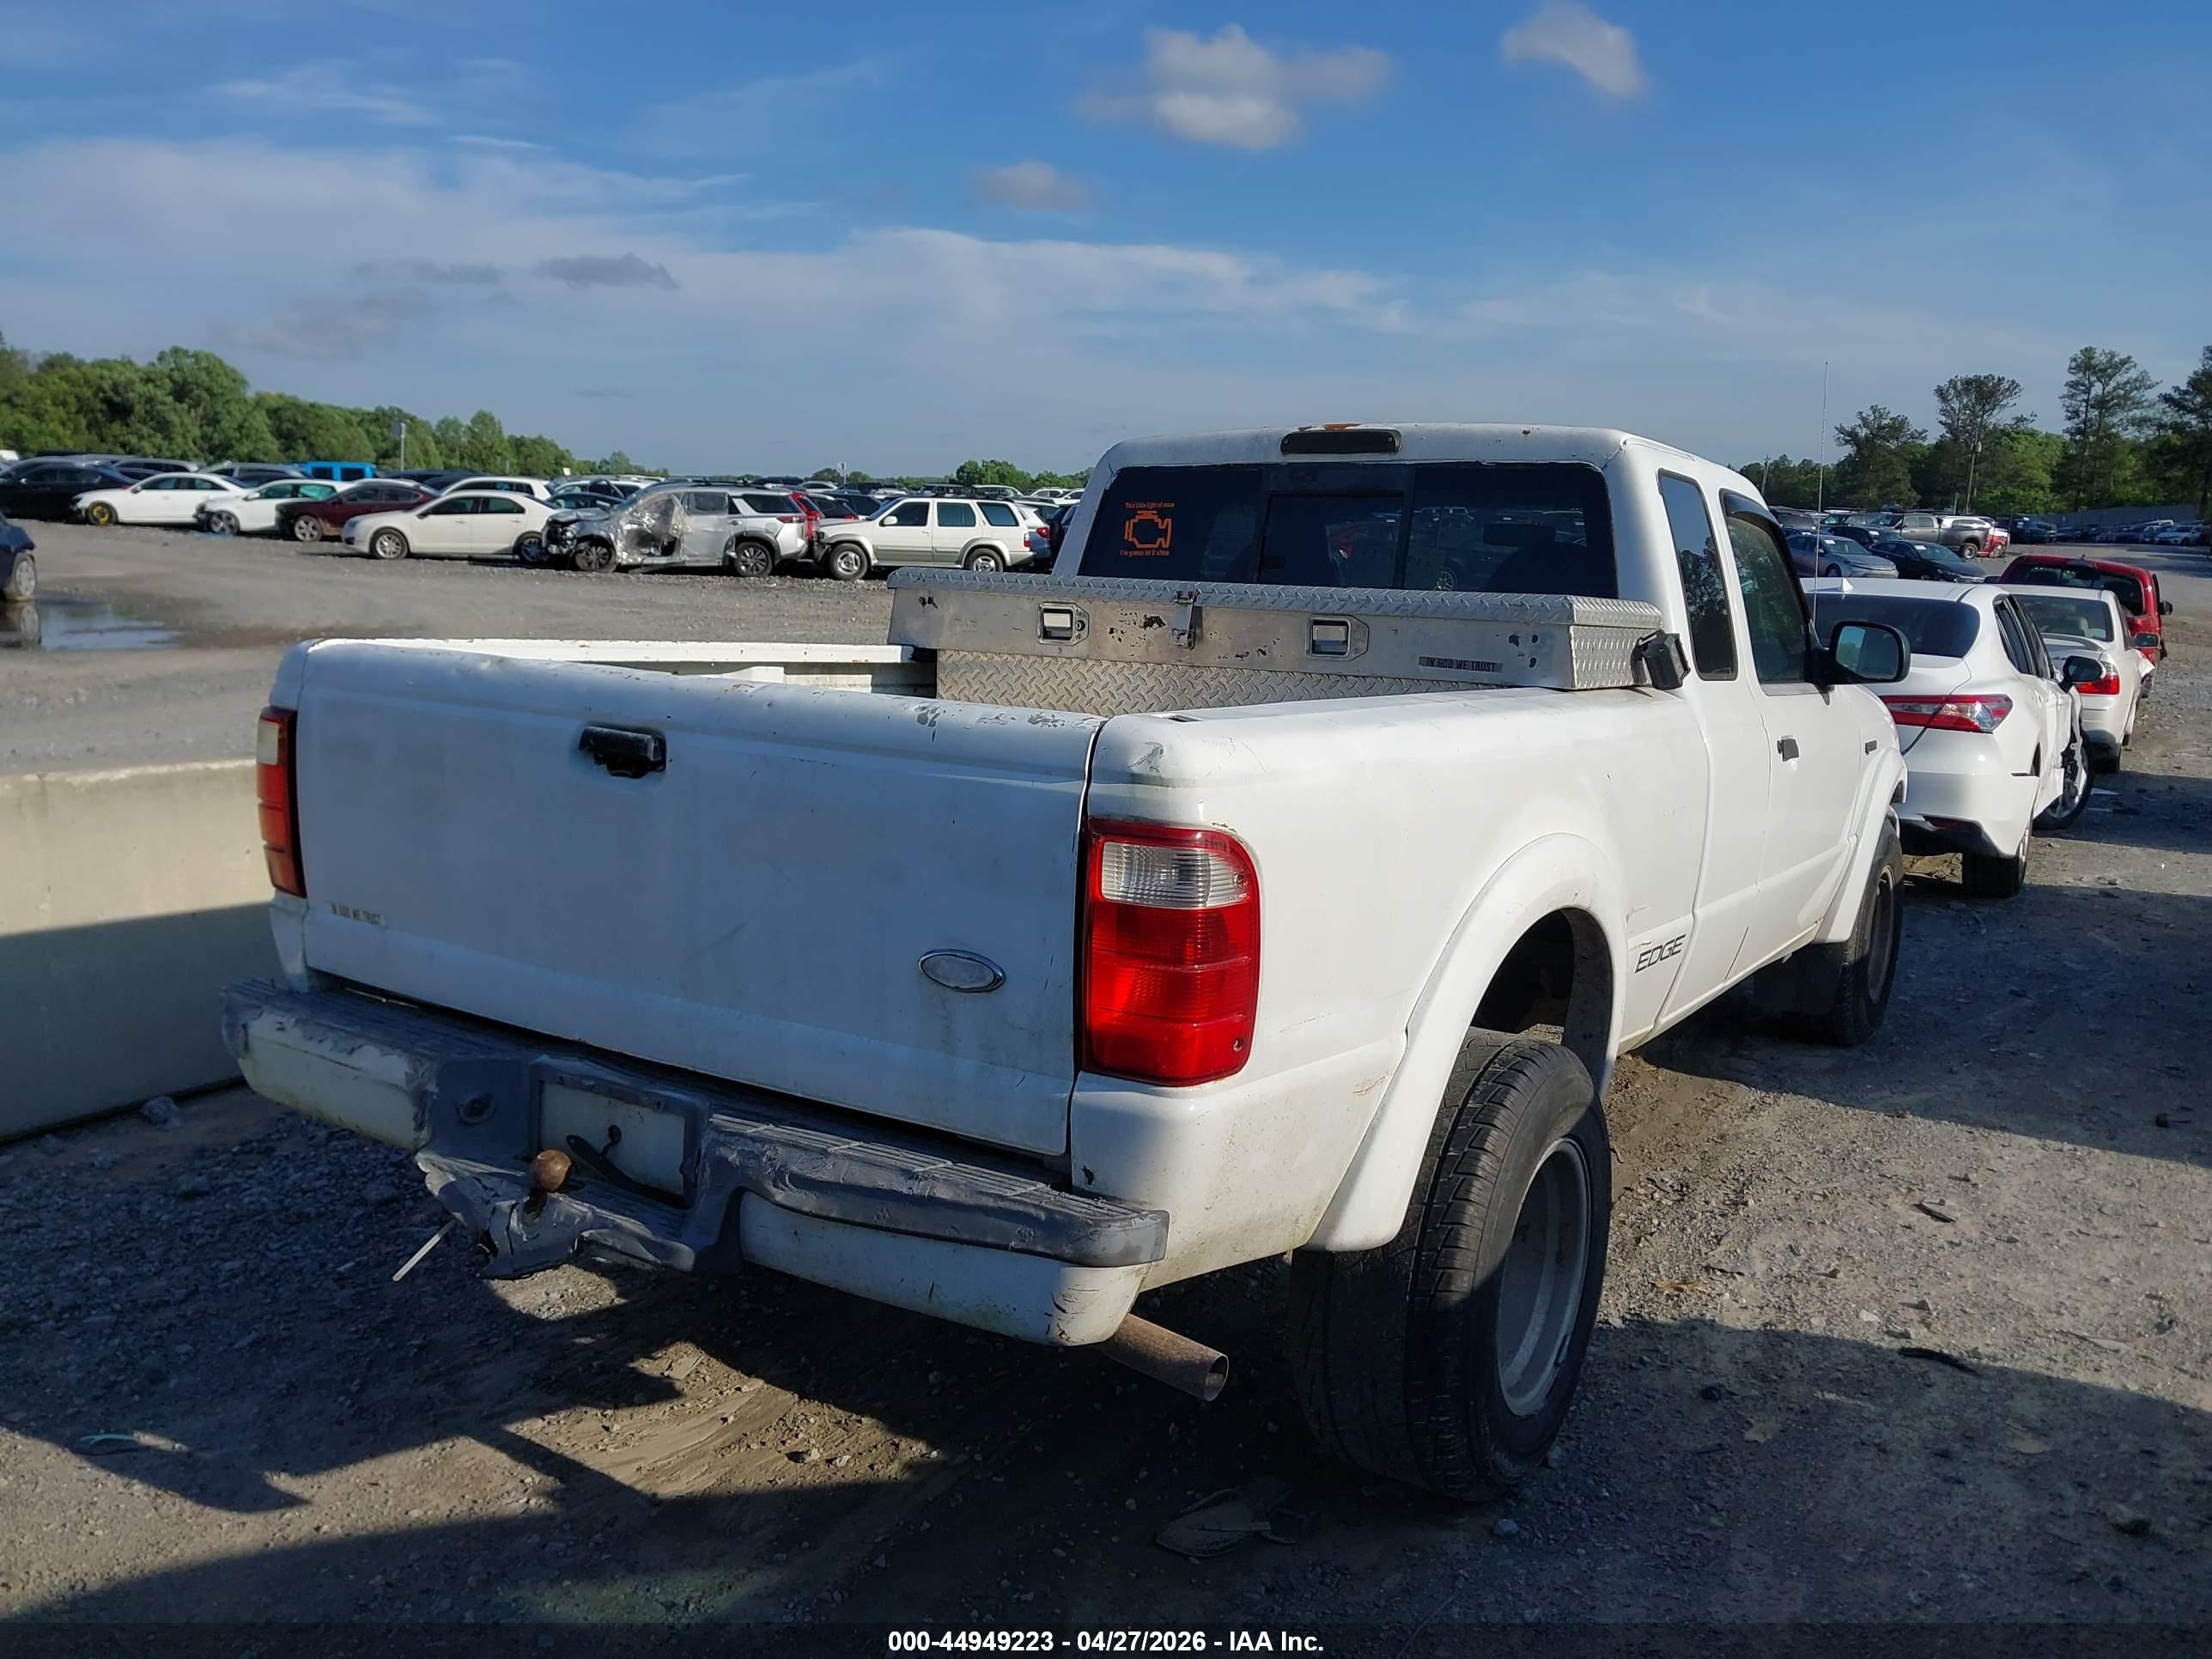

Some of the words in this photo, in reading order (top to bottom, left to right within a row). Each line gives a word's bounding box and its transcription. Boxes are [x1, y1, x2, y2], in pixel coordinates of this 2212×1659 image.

[1427, 657, 1435, 667] IN
[1437, 658, 1454, 668] GOD
[1456, 659, 1470, 670] WE
[1471, 660, 1496, 672] TRUST
[1635, 933, 1686, 973] EDGE
